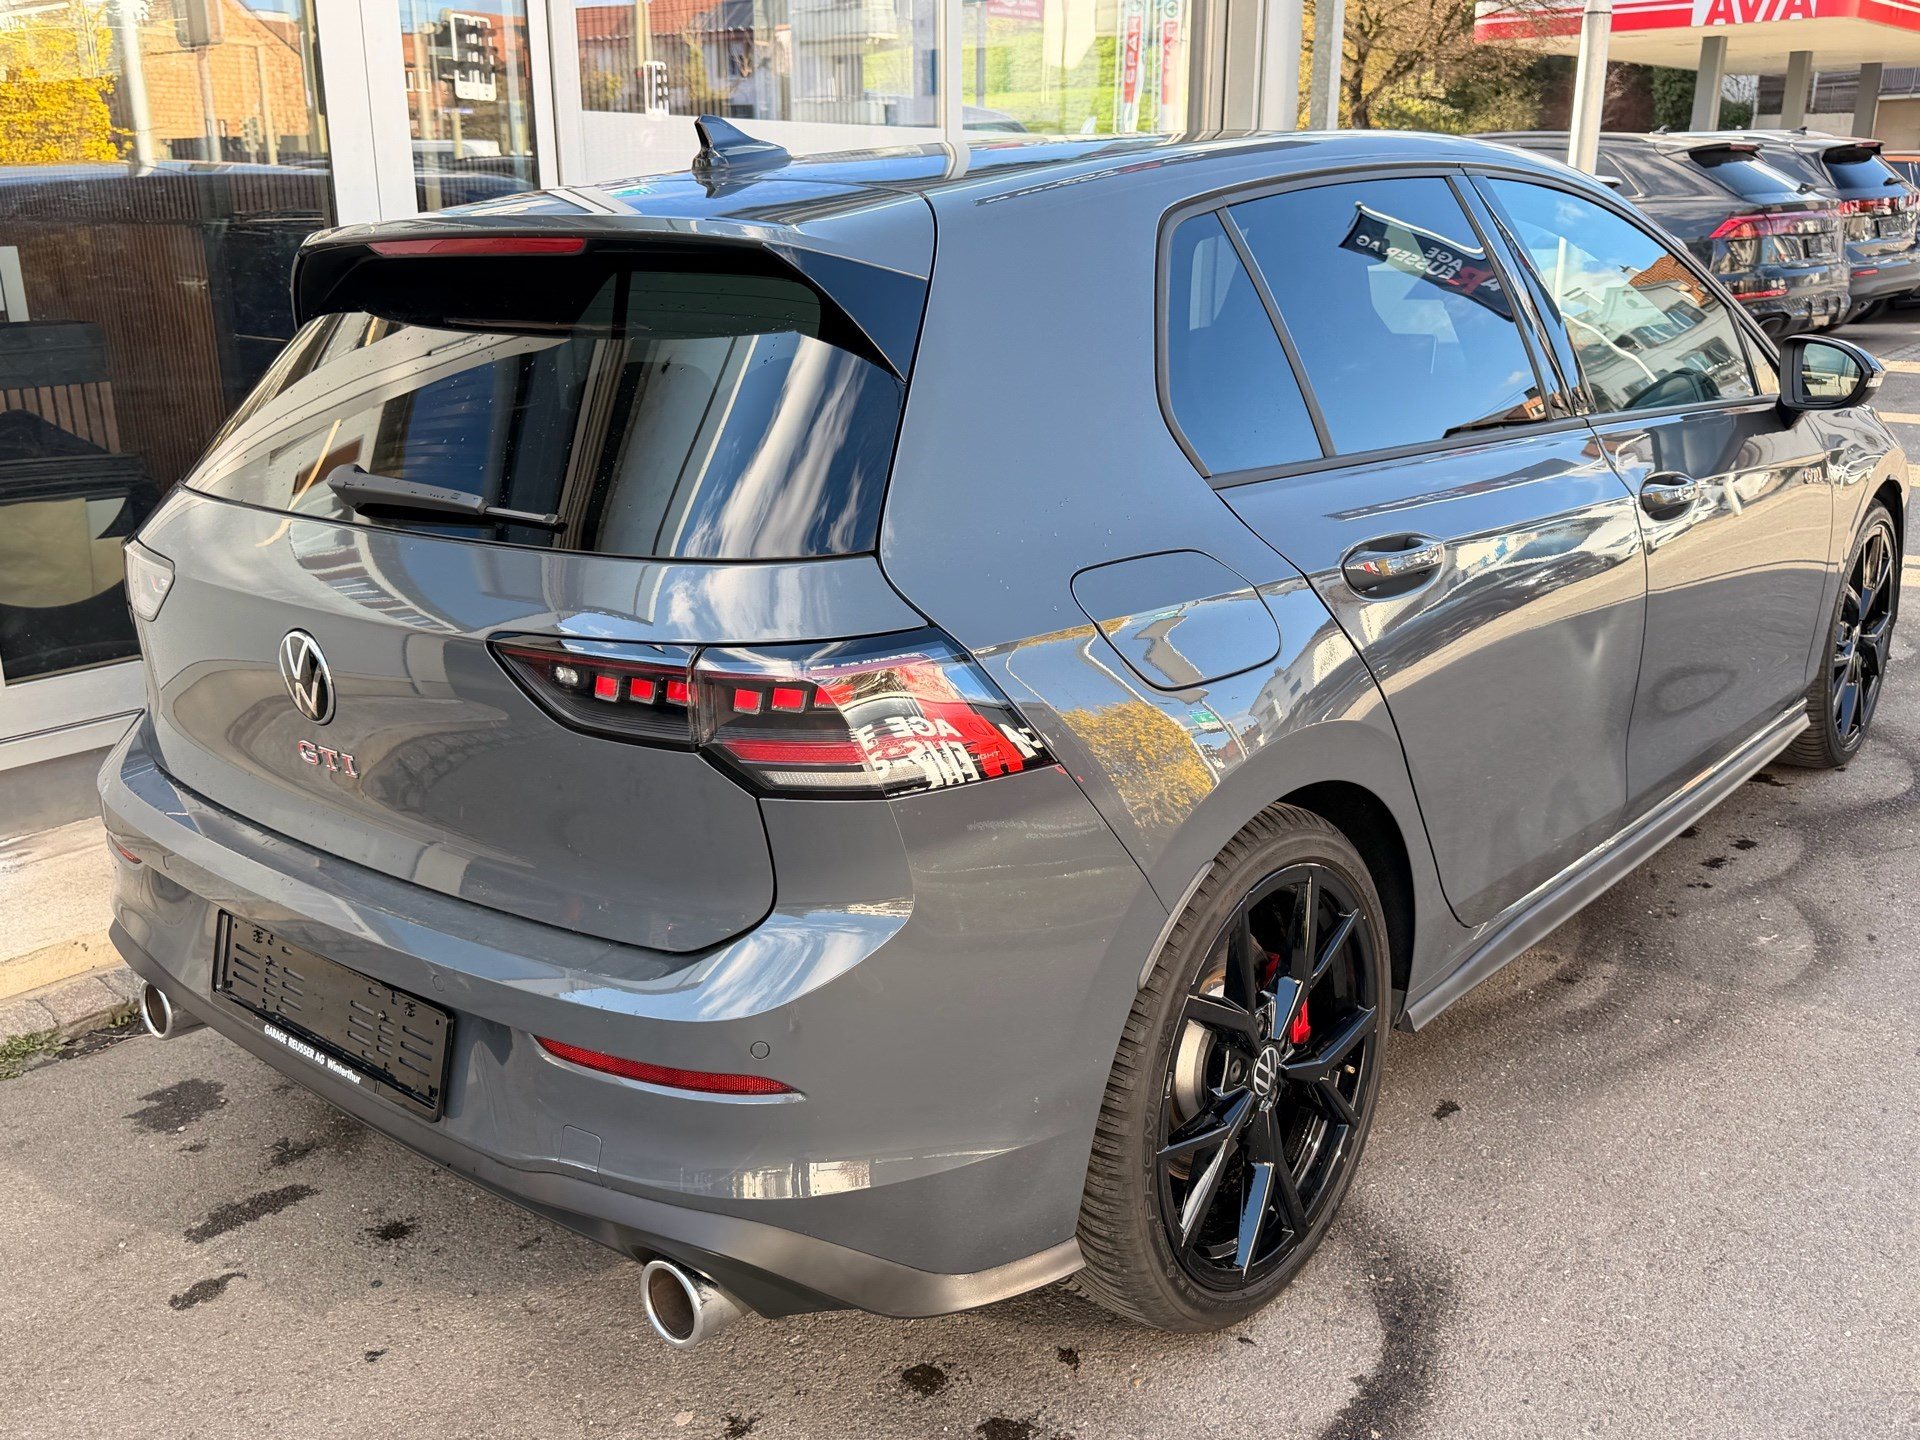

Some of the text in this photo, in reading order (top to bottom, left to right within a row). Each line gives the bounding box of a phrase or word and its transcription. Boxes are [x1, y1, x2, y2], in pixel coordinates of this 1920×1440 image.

[1704, 0, 1817, 26] AVIA
[297, 739, 360, 780] GTI
[264, 1024, 361, 1085] GARAGE REUSSER AG Winterthur
